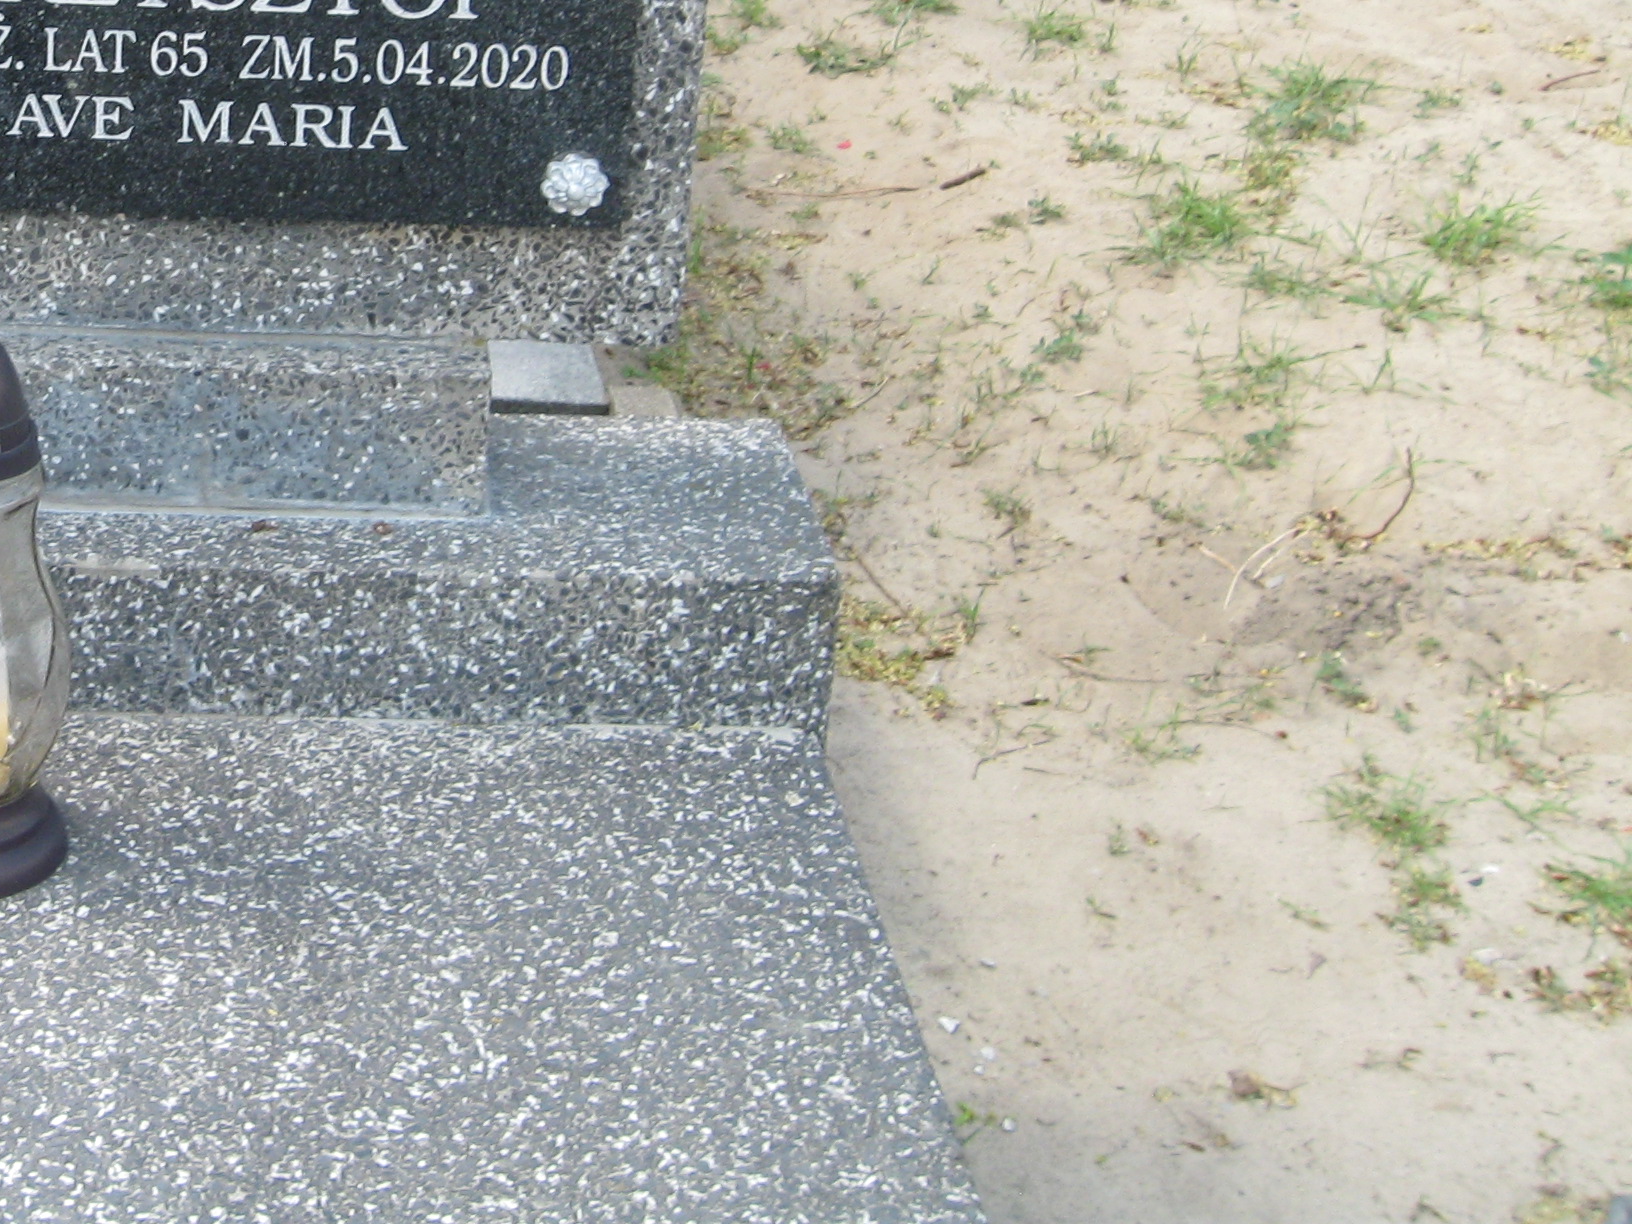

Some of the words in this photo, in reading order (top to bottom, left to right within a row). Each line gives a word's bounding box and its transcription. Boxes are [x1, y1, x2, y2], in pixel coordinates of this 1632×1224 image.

[44, 27, 136, 74] LAT
[149, 30, 209, 79] 65
[6, 94, 136, 143] AVE
[177, 98, 410, 152] MARIA
